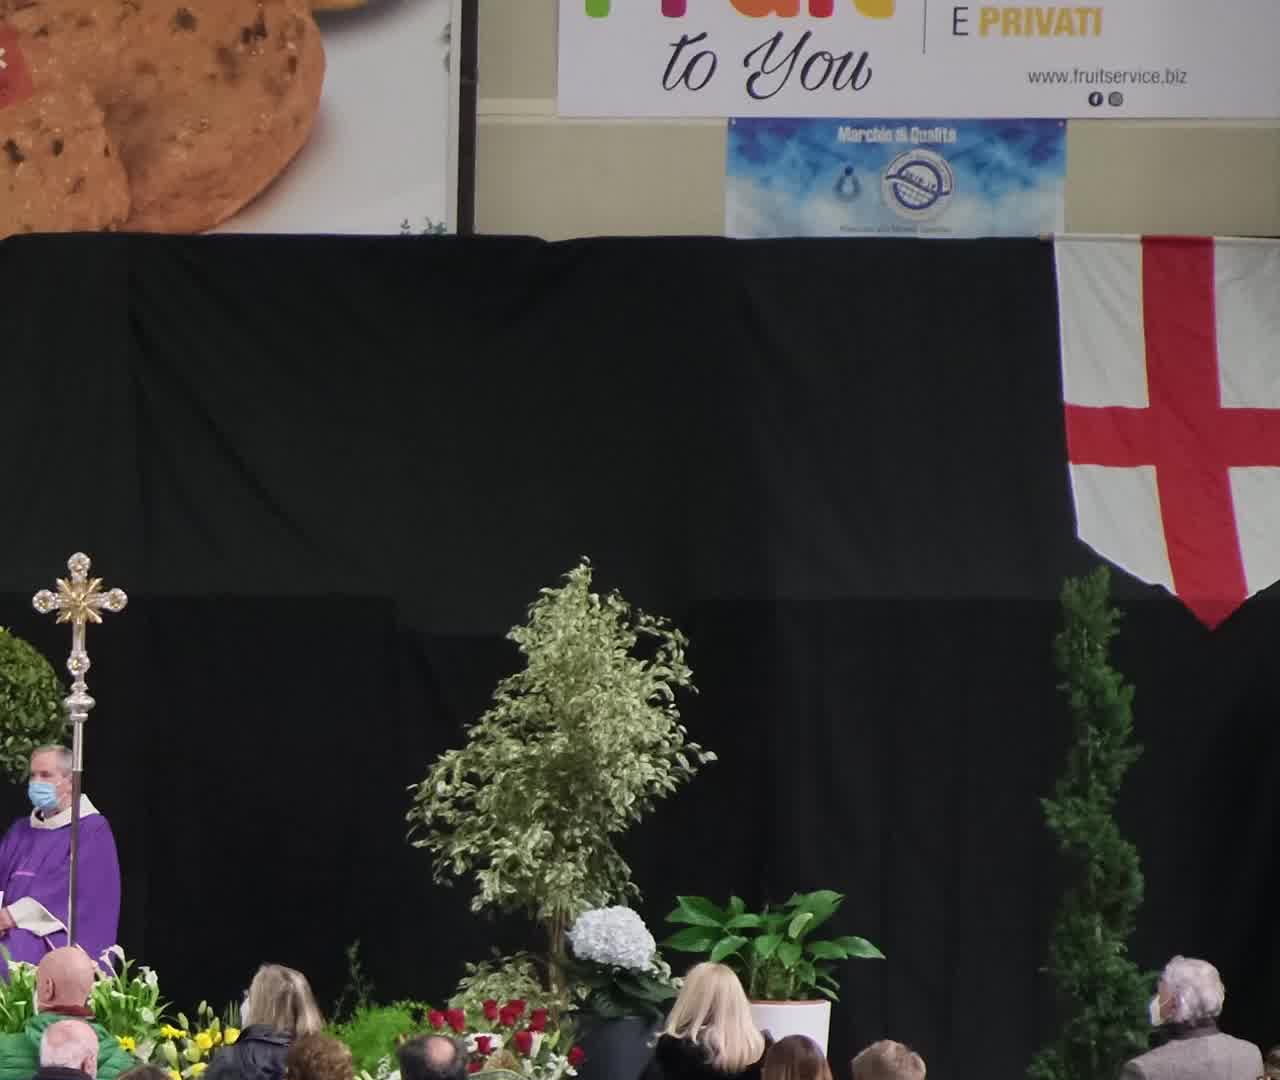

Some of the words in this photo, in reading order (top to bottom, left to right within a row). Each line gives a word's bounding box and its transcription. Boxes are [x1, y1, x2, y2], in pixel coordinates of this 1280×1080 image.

[952, 7, 969, 36] E
[978, 6, 1105, 37] PRIVATI
[662, 31, 718, 91] to
[743, 30, 873, 100] You
[1028, 68, 1188, 85] www.fruitservice.biz
